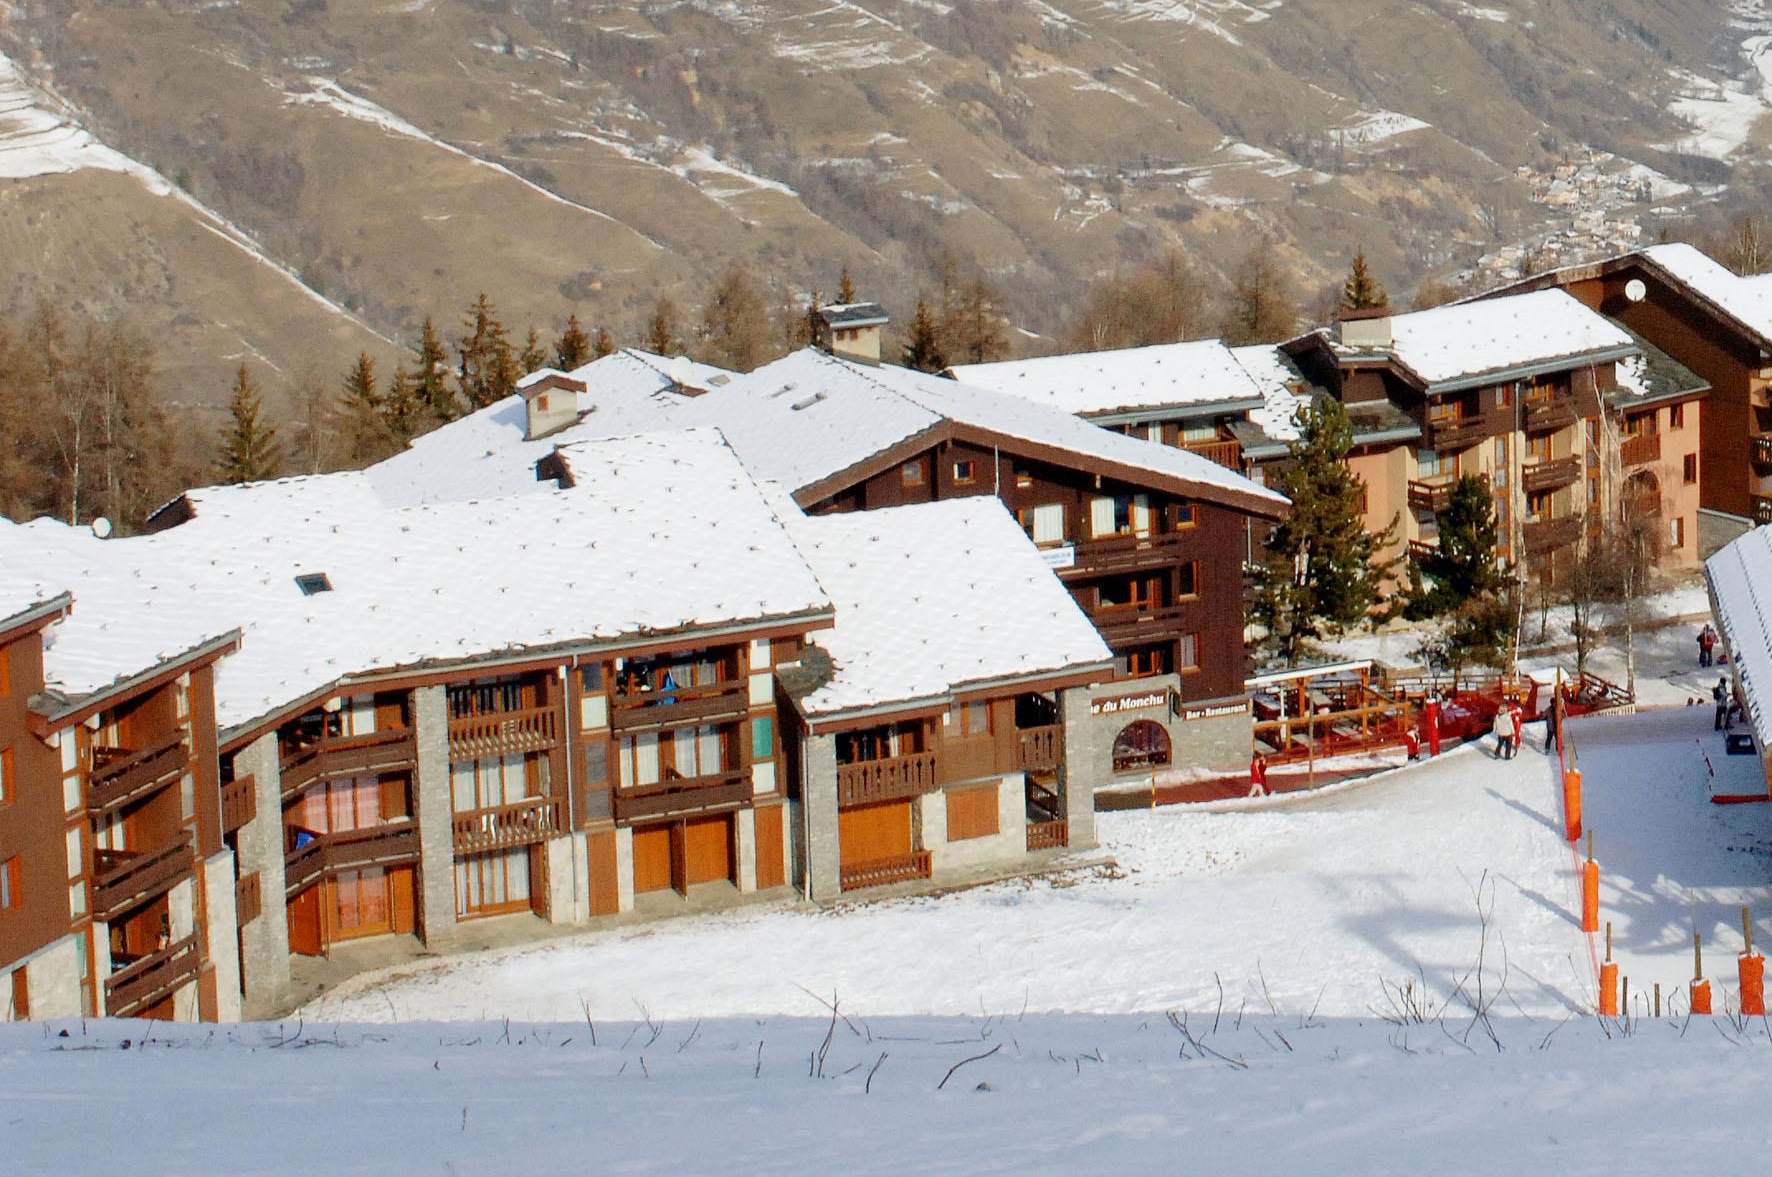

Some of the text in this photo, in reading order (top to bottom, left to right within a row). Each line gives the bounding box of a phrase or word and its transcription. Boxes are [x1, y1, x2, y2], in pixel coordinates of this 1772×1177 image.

[1103, 700, 1118, 712] du
[1120, 694, 1165, 710] Monchu
[1186, 703, 1247, 720] Bar Restaurant
